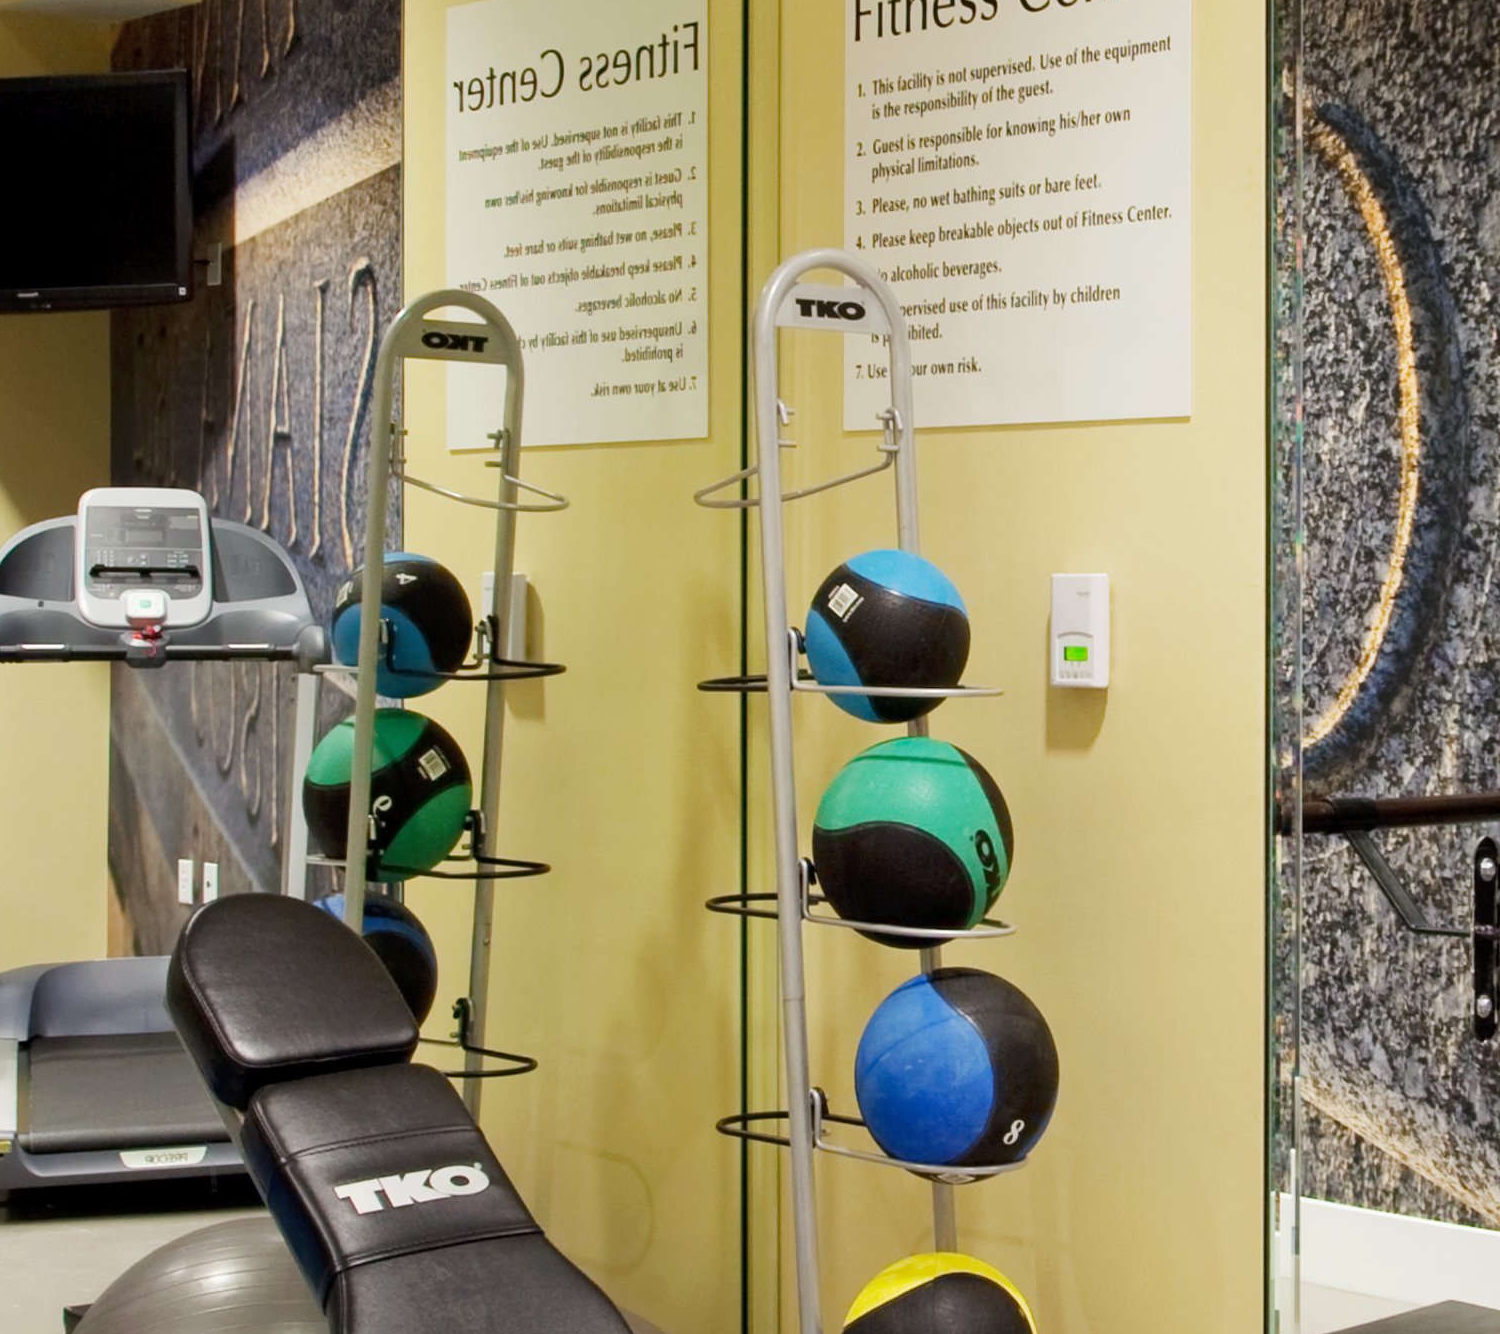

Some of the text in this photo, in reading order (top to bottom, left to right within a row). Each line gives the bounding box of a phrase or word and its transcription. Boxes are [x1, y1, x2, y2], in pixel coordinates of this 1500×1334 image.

[856, 35, 1171, 98] 1. This facility is not supervised. Use of the equipment
[871, 80, 1053, 120] is the responsibility of the guest.
[855, 109, 1130, 157] 2. Guest is responsible for knowing his/her own
[871, 154, 979, 184] physical limitations.
[855, 173, 1101, 216] 3. Please, no wet bathing suits or bare feet.
[855, 205, 1171, 250] 4. Please keep breakable objects out of Fitness Center.
[890, 262, 939, 283] alcoholic
[942, 260, 1002, 279] beverages.
[796, 298, 865, 320] TKO
[948, 300, 969, 313] use
[971, 293, 984, 311] of
[986, 292, 1007, 310] this
[1010, 289, 1049, 310] facility
[1052, 288, 1067, 309] by
[1070, 284, 1120, 303] children
[867, 363, 887, 379] Use
[930, 362, 954, 375] own
[957, 356, 982, 373] risk.
[1003, 1119, 1025, 1145] 8
[334, 1164, 490, 1215] TKO
